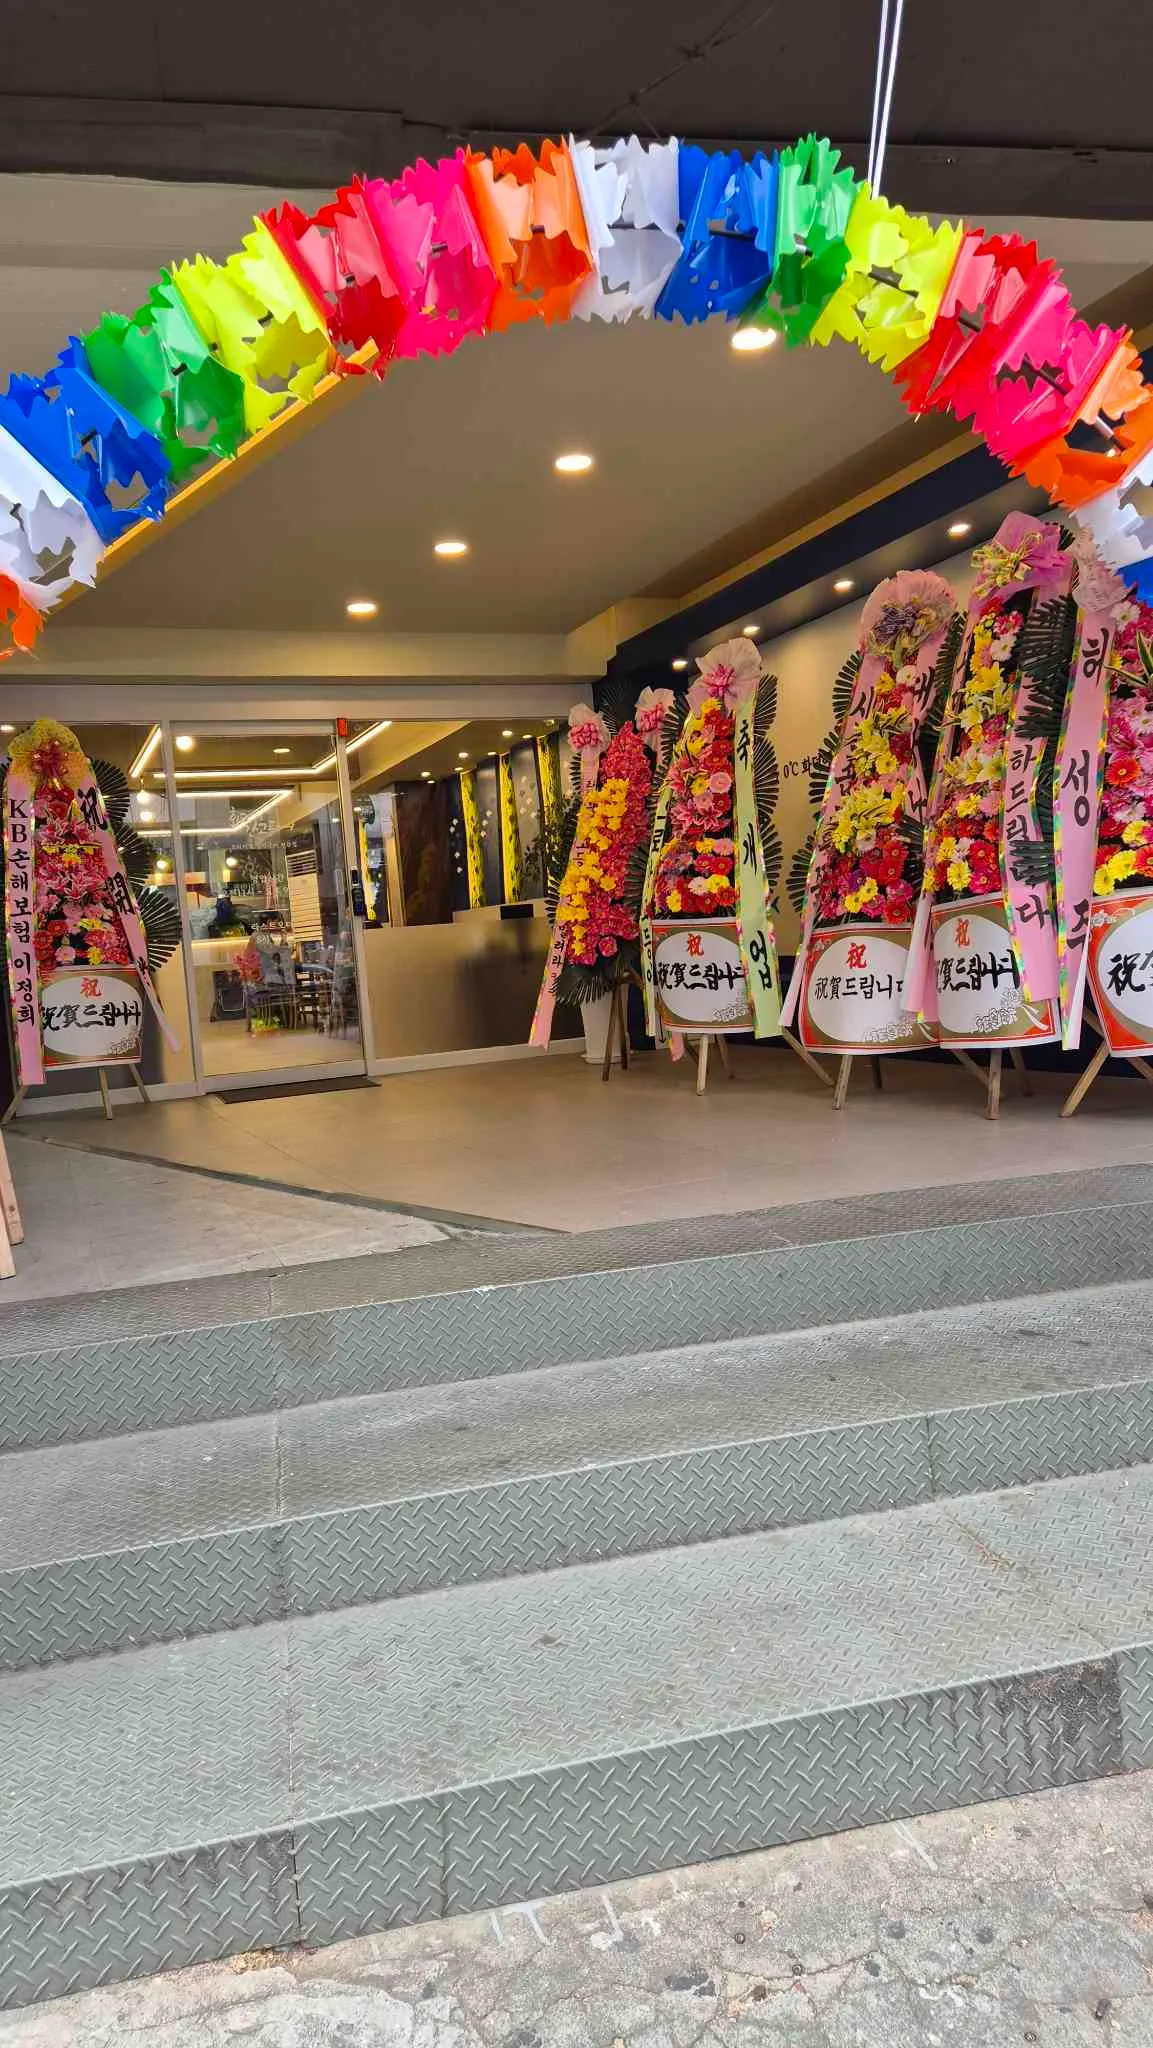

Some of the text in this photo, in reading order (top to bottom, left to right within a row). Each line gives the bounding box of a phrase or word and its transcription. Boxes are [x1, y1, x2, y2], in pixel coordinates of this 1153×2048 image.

[8, 798, 35, 1027] KB손해보험 이정희
[686, 933, 705, 957] 祝
[955, 917, 971, 946] 祝
[846, 942, 868, 969] 祝
[80, 977, 102, 998] 祝
